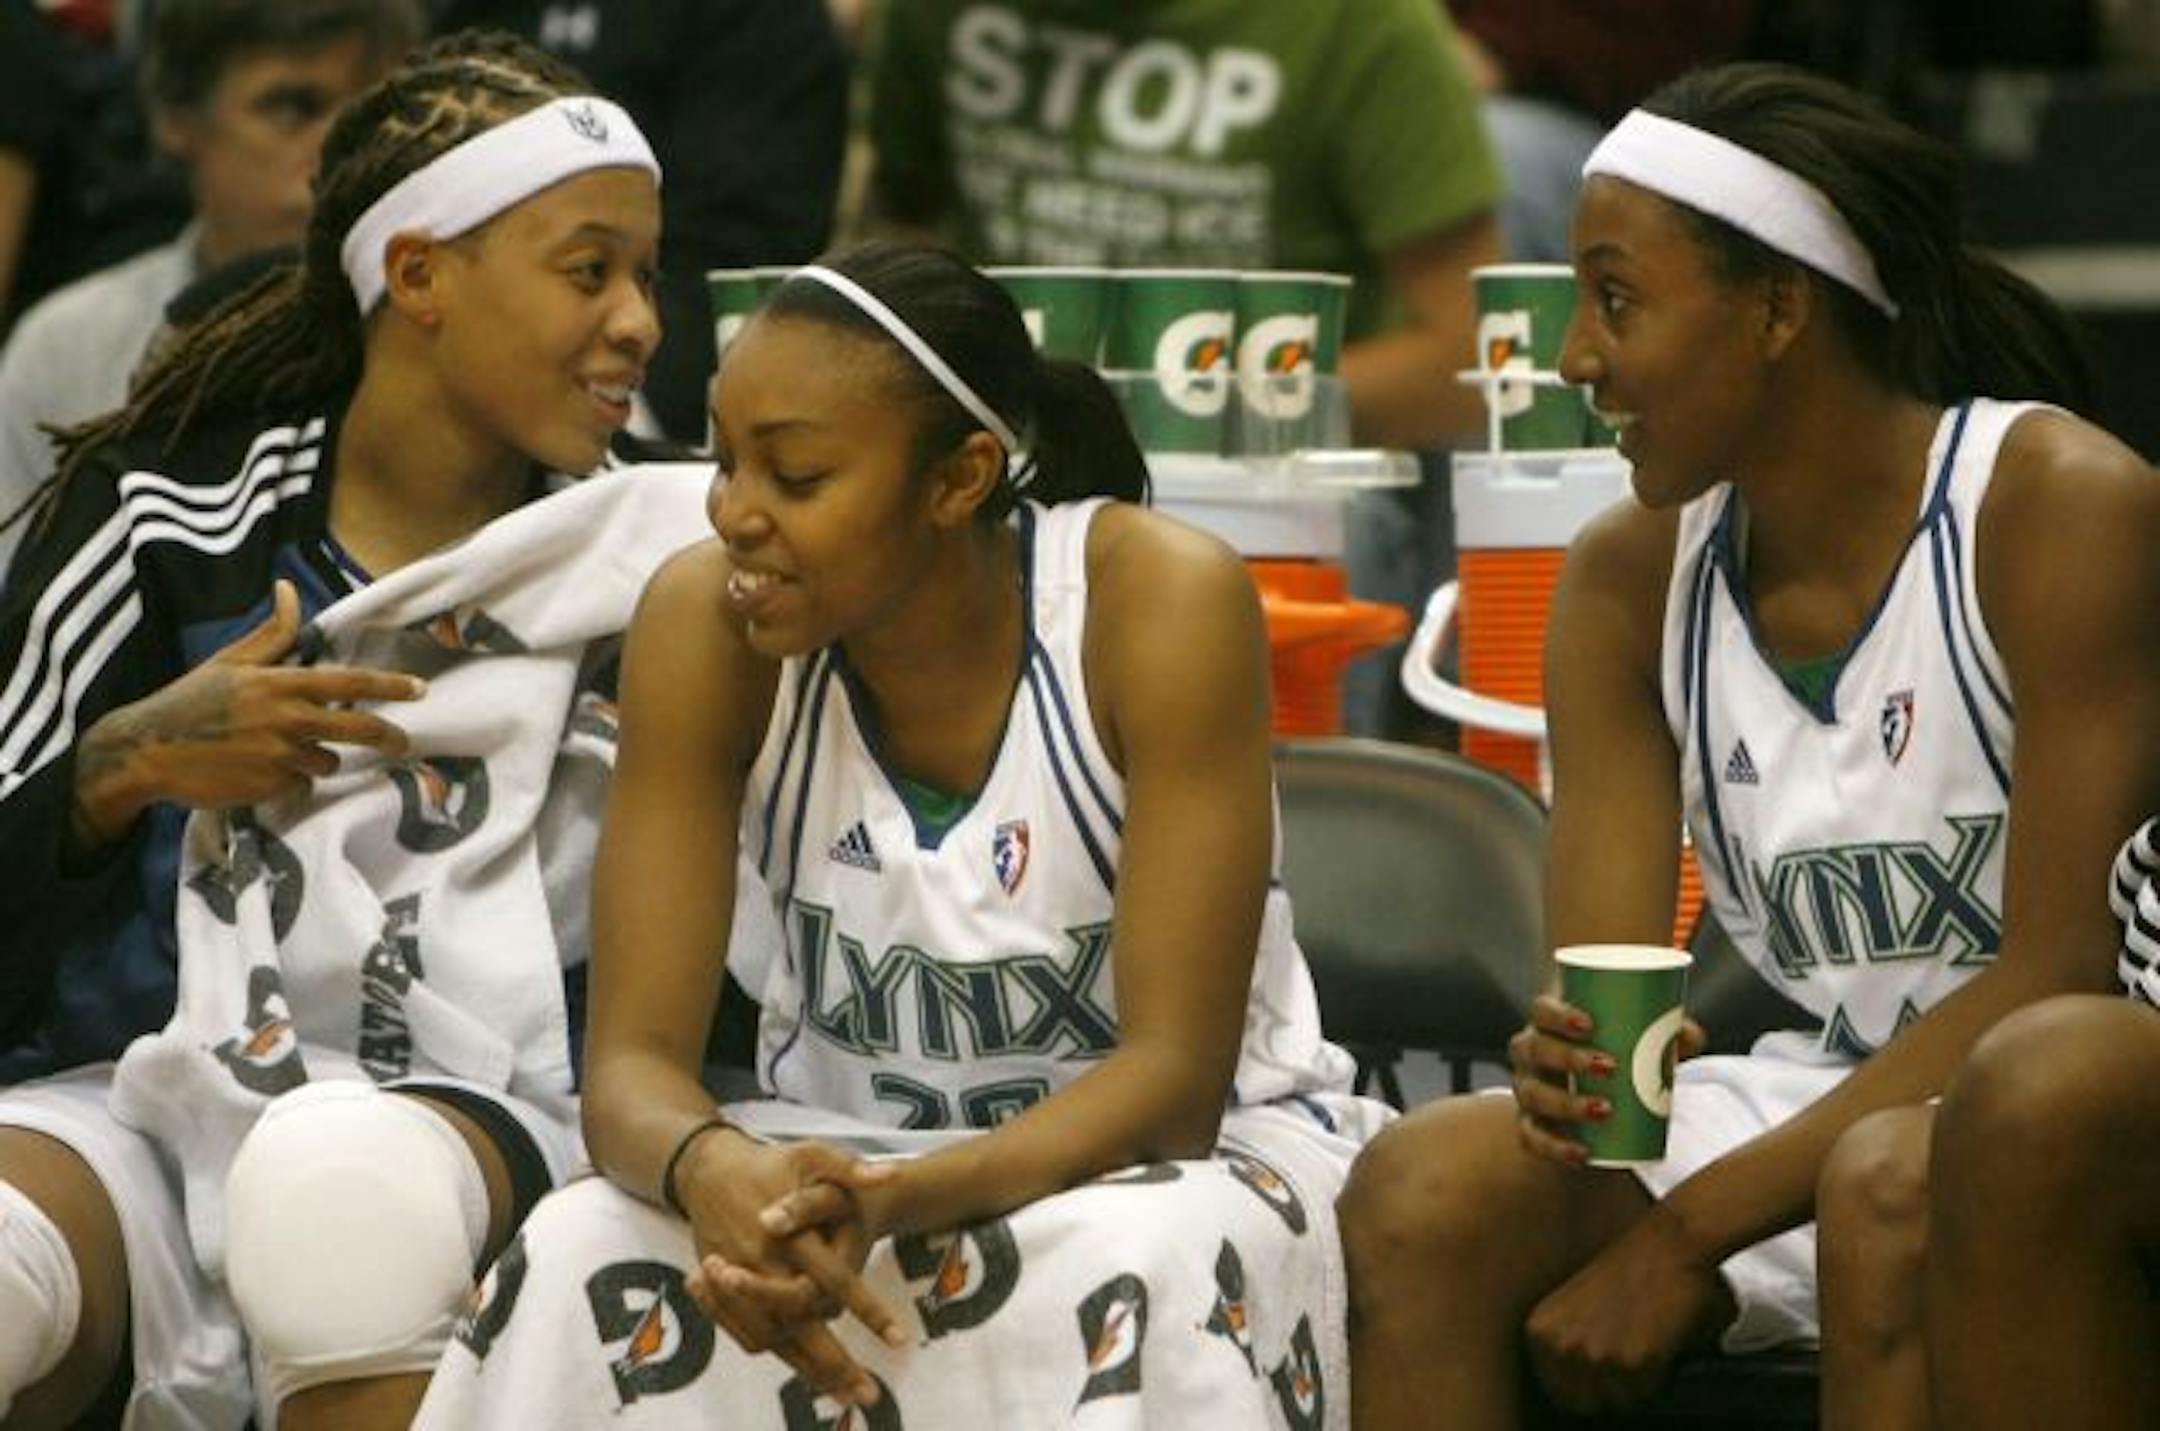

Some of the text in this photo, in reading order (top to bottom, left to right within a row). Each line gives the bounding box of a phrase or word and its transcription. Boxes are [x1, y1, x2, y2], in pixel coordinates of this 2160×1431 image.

[948, 4, 1282, 154] STOP
[1155, 311, 1235, 418] G
[1239, 313, 1318, 420] G
[790, 898, 1121, 1060] LYNX
